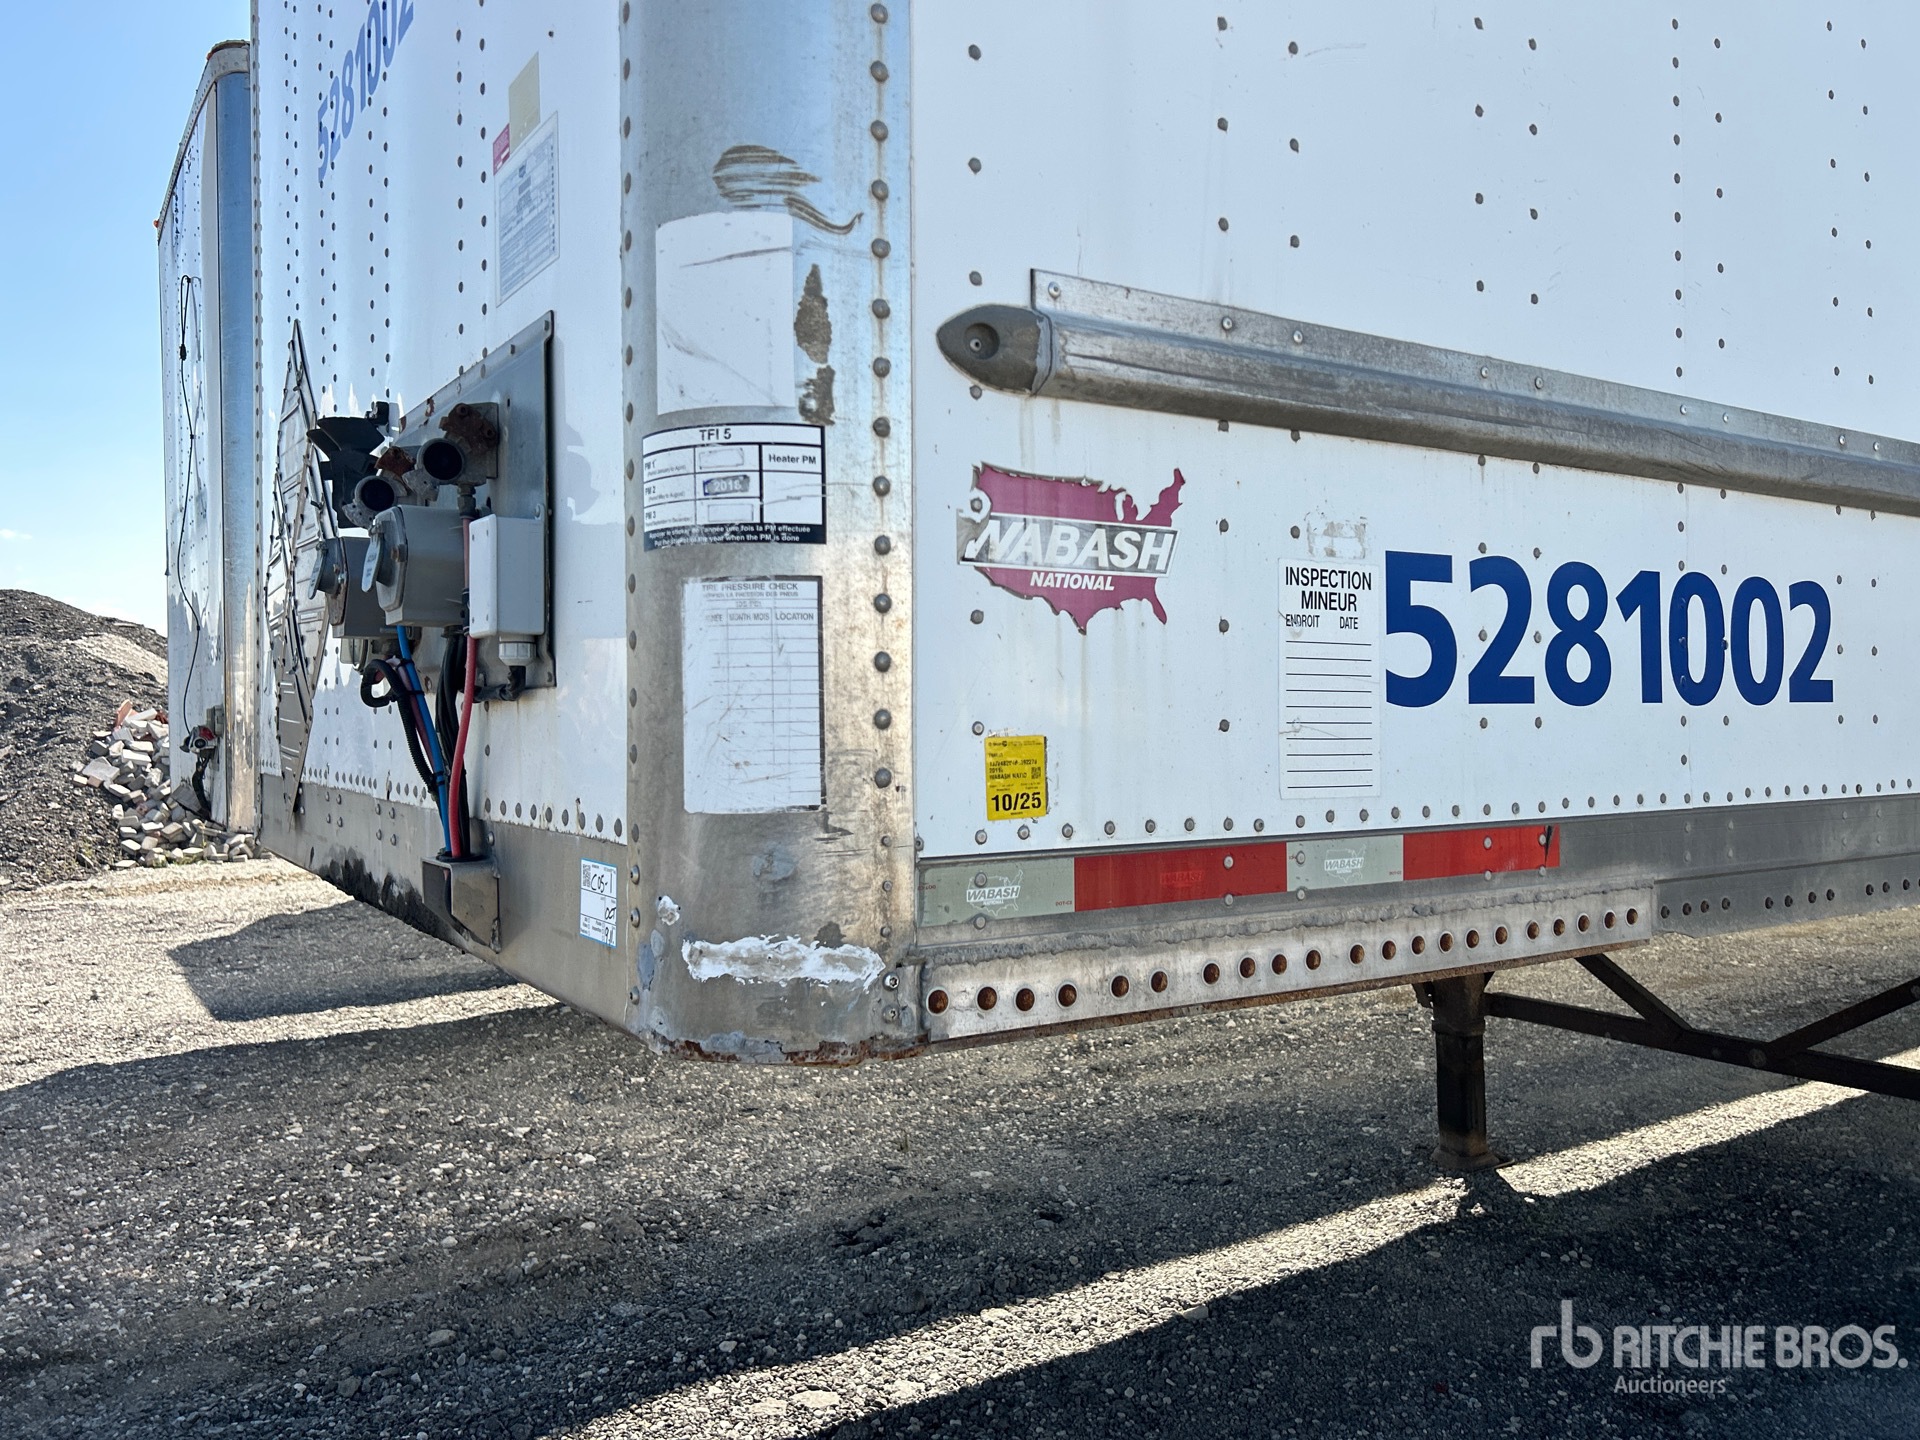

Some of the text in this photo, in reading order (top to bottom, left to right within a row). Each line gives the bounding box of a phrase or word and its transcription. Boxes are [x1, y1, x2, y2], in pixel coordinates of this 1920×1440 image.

[699, 428, 732, 441] TFI 5
[769, 454, 816, 465] Heater PM
[714, 479, 741, 492] 2018
[778, 525, 811, 533] effectuée
[709, 536, 723, 544] year
[781, 533, 800, 542] done
[964, 519, 1174, 571] WABASH
[1030, 572, 1115, 591] NATIONAL
[1286, 566, 1372, 590] INSPECTION
[722, 583, 766, 591] PRESSURE
[1301, 590, 1357, 612] MINEUR
[775, 612, 814, 621] LOCATION
[1286, 614, 1358, 630] ENDROIT DATE
[1386, 550, 1834, 708] 5281002
[991, 791, 1042, 811] 10/25
[1325, 859, 1363, 870] WABASH
[967, 886, 1020, 901] WABASH
